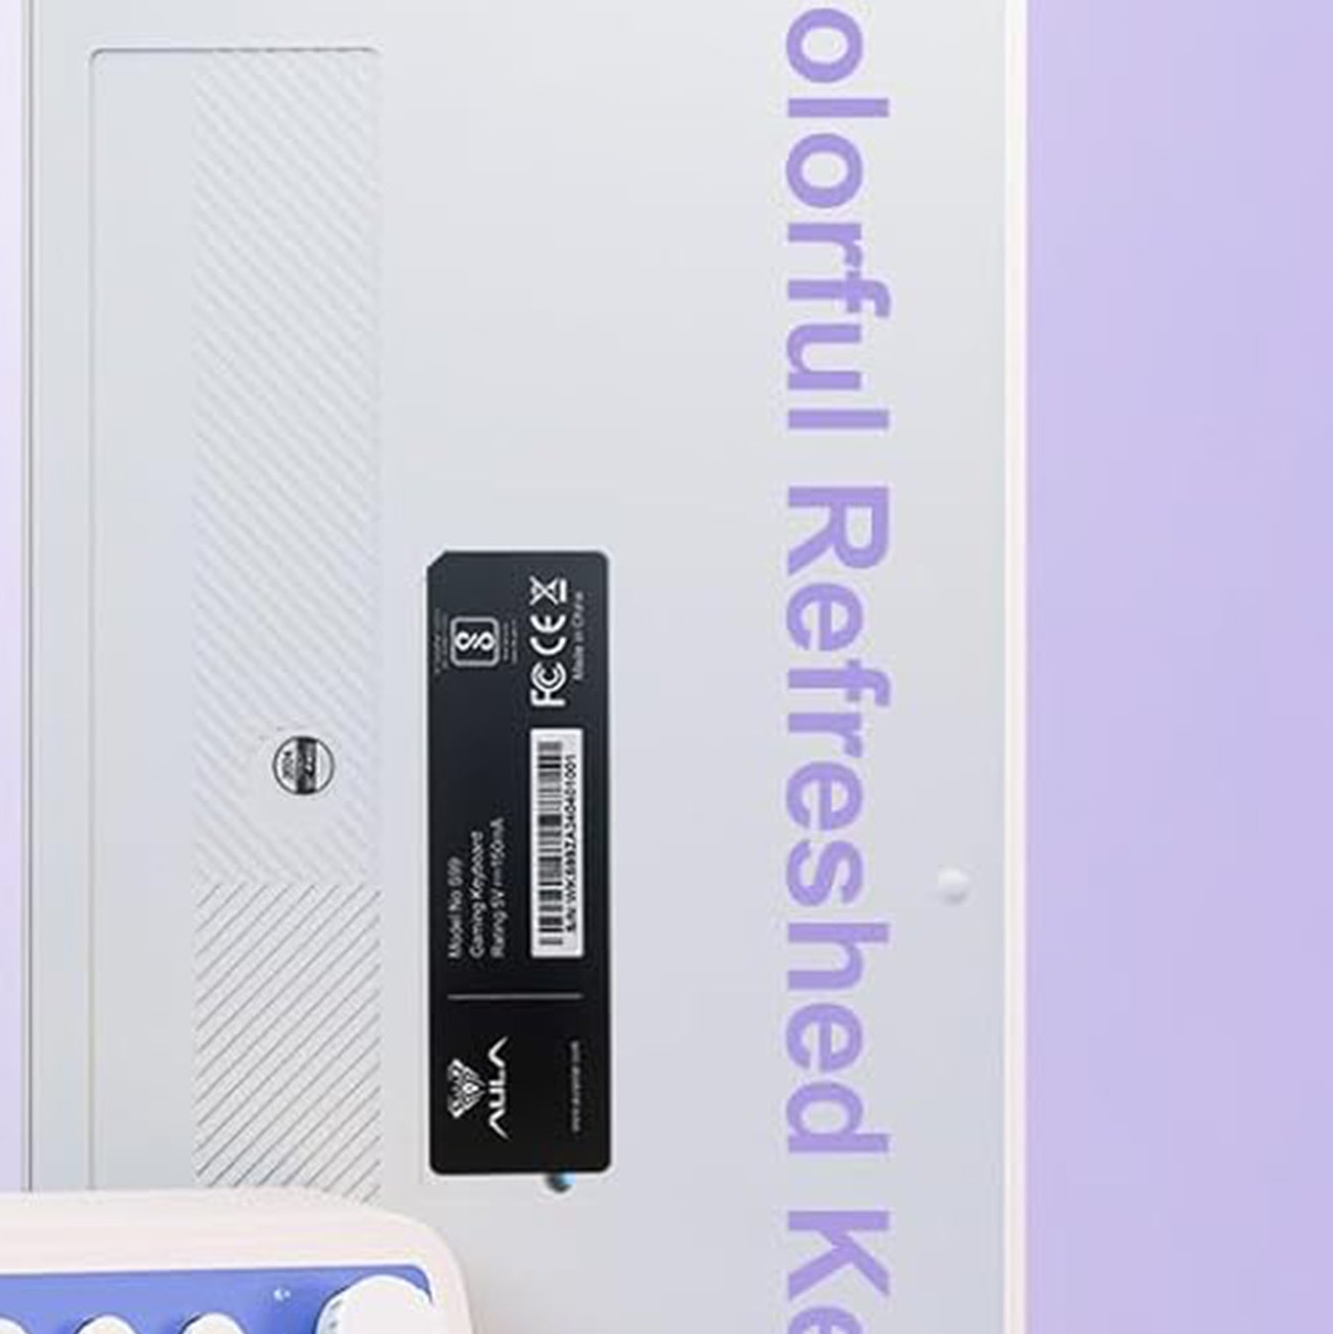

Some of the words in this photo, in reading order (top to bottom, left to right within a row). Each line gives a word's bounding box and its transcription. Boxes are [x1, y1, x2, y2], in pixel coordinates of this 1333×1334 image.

[469, 830, 486, 899] Keyboard
[469, 901, 486, 958] Gaming
[487, 1036, 510, 1140] AULA
